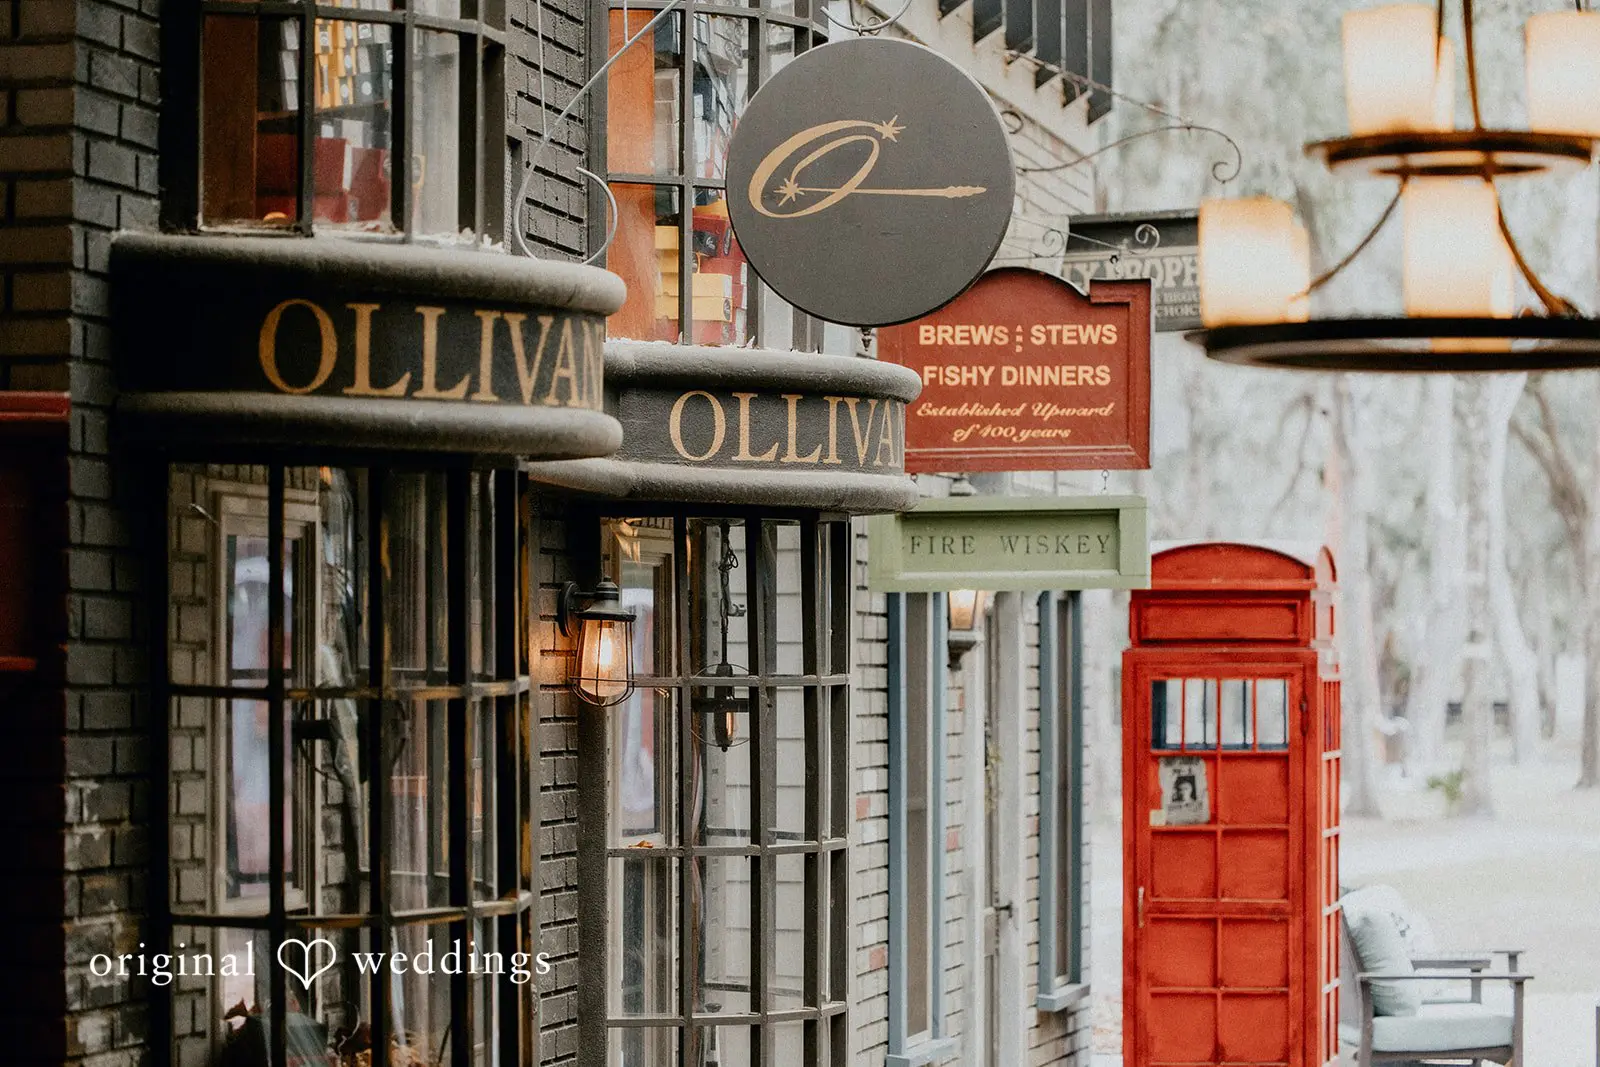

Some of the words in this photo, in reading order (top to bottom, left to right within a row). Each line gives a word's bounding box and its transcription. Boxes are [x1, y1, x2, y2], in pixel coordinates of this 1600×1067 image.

[919, 325, 1009, 345] BREWS
[1030, 324, 1118, 345] STEWS
[923, 366, 995, 386] FISHY
[1001, 365, 1111, 386] DINNERS
[917, 402, 1027, 417] Established
[1031, 402, 1115, 421] Upward
[953, 424, 980, 443] of
[1012, 427, 1072, 442] years
[910, 535, 976, 554] FIRE
[1000, 534, 1110, 554] WISKEY
